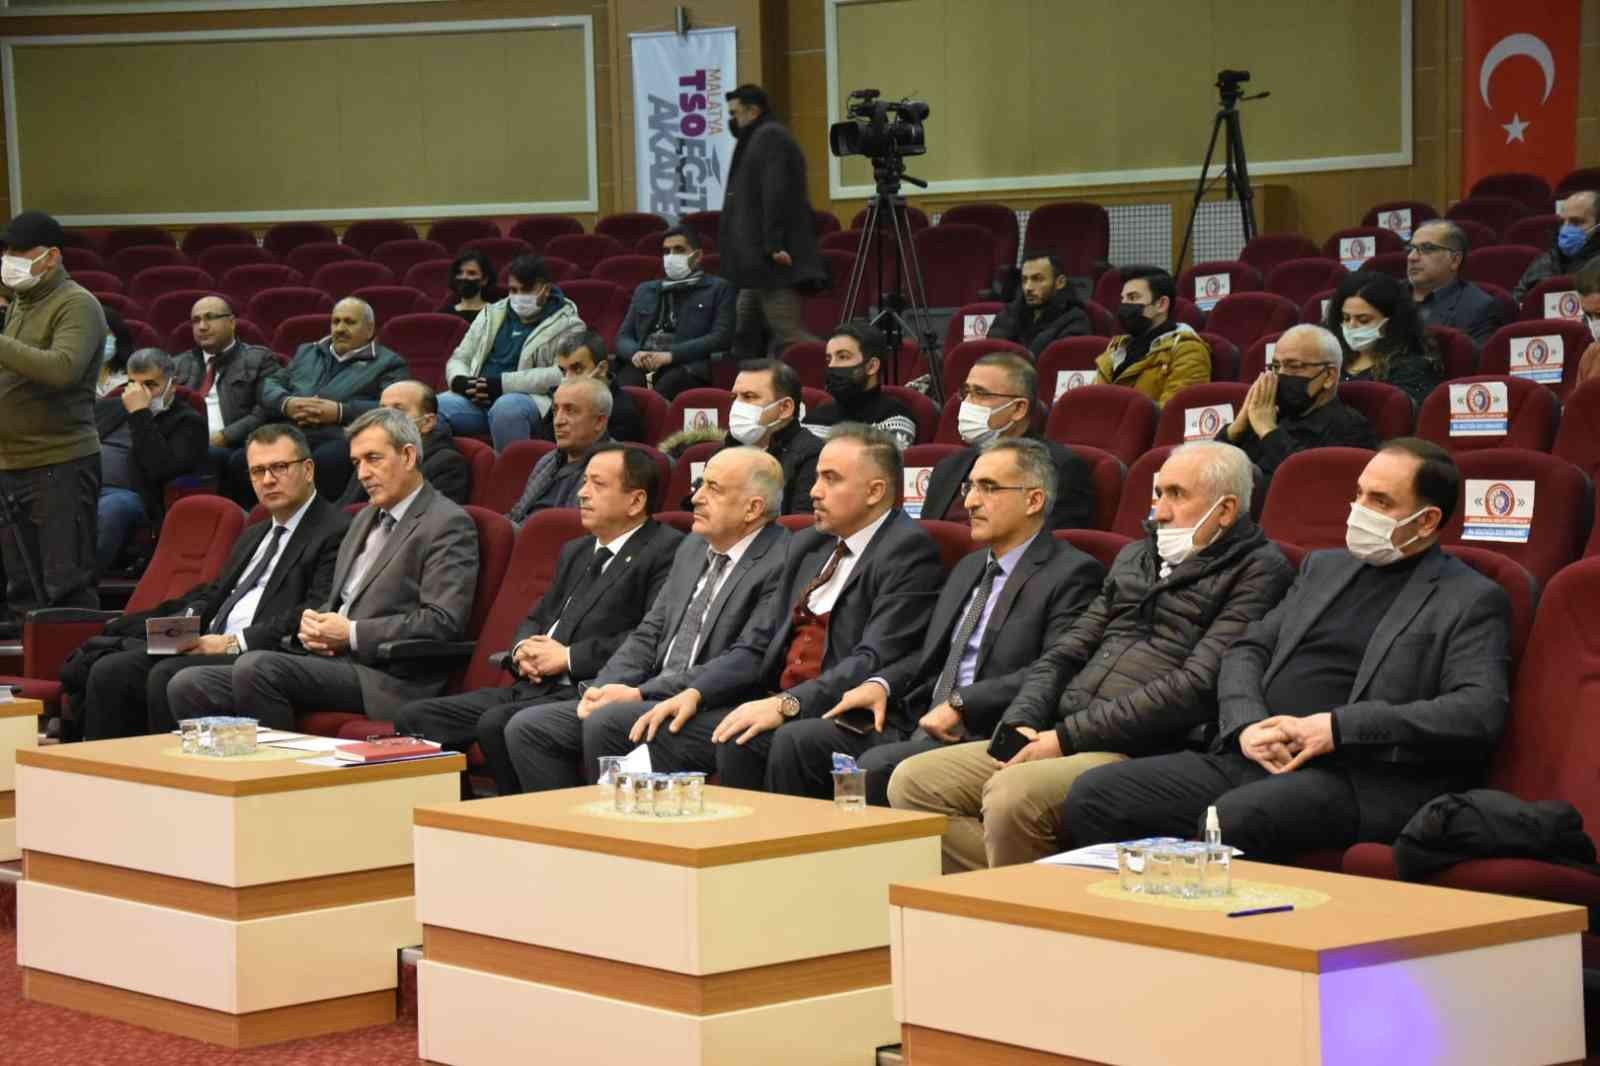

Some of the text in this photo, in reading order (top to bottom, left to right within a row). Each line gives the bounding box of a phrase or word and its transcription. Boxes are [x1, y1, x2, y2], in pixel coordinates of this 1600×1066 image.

[648, 94, 681, 219] AKADE
[677, 68, 710, 213] TSO EĞİT
[708, 68, 723, 136] MALATYA
